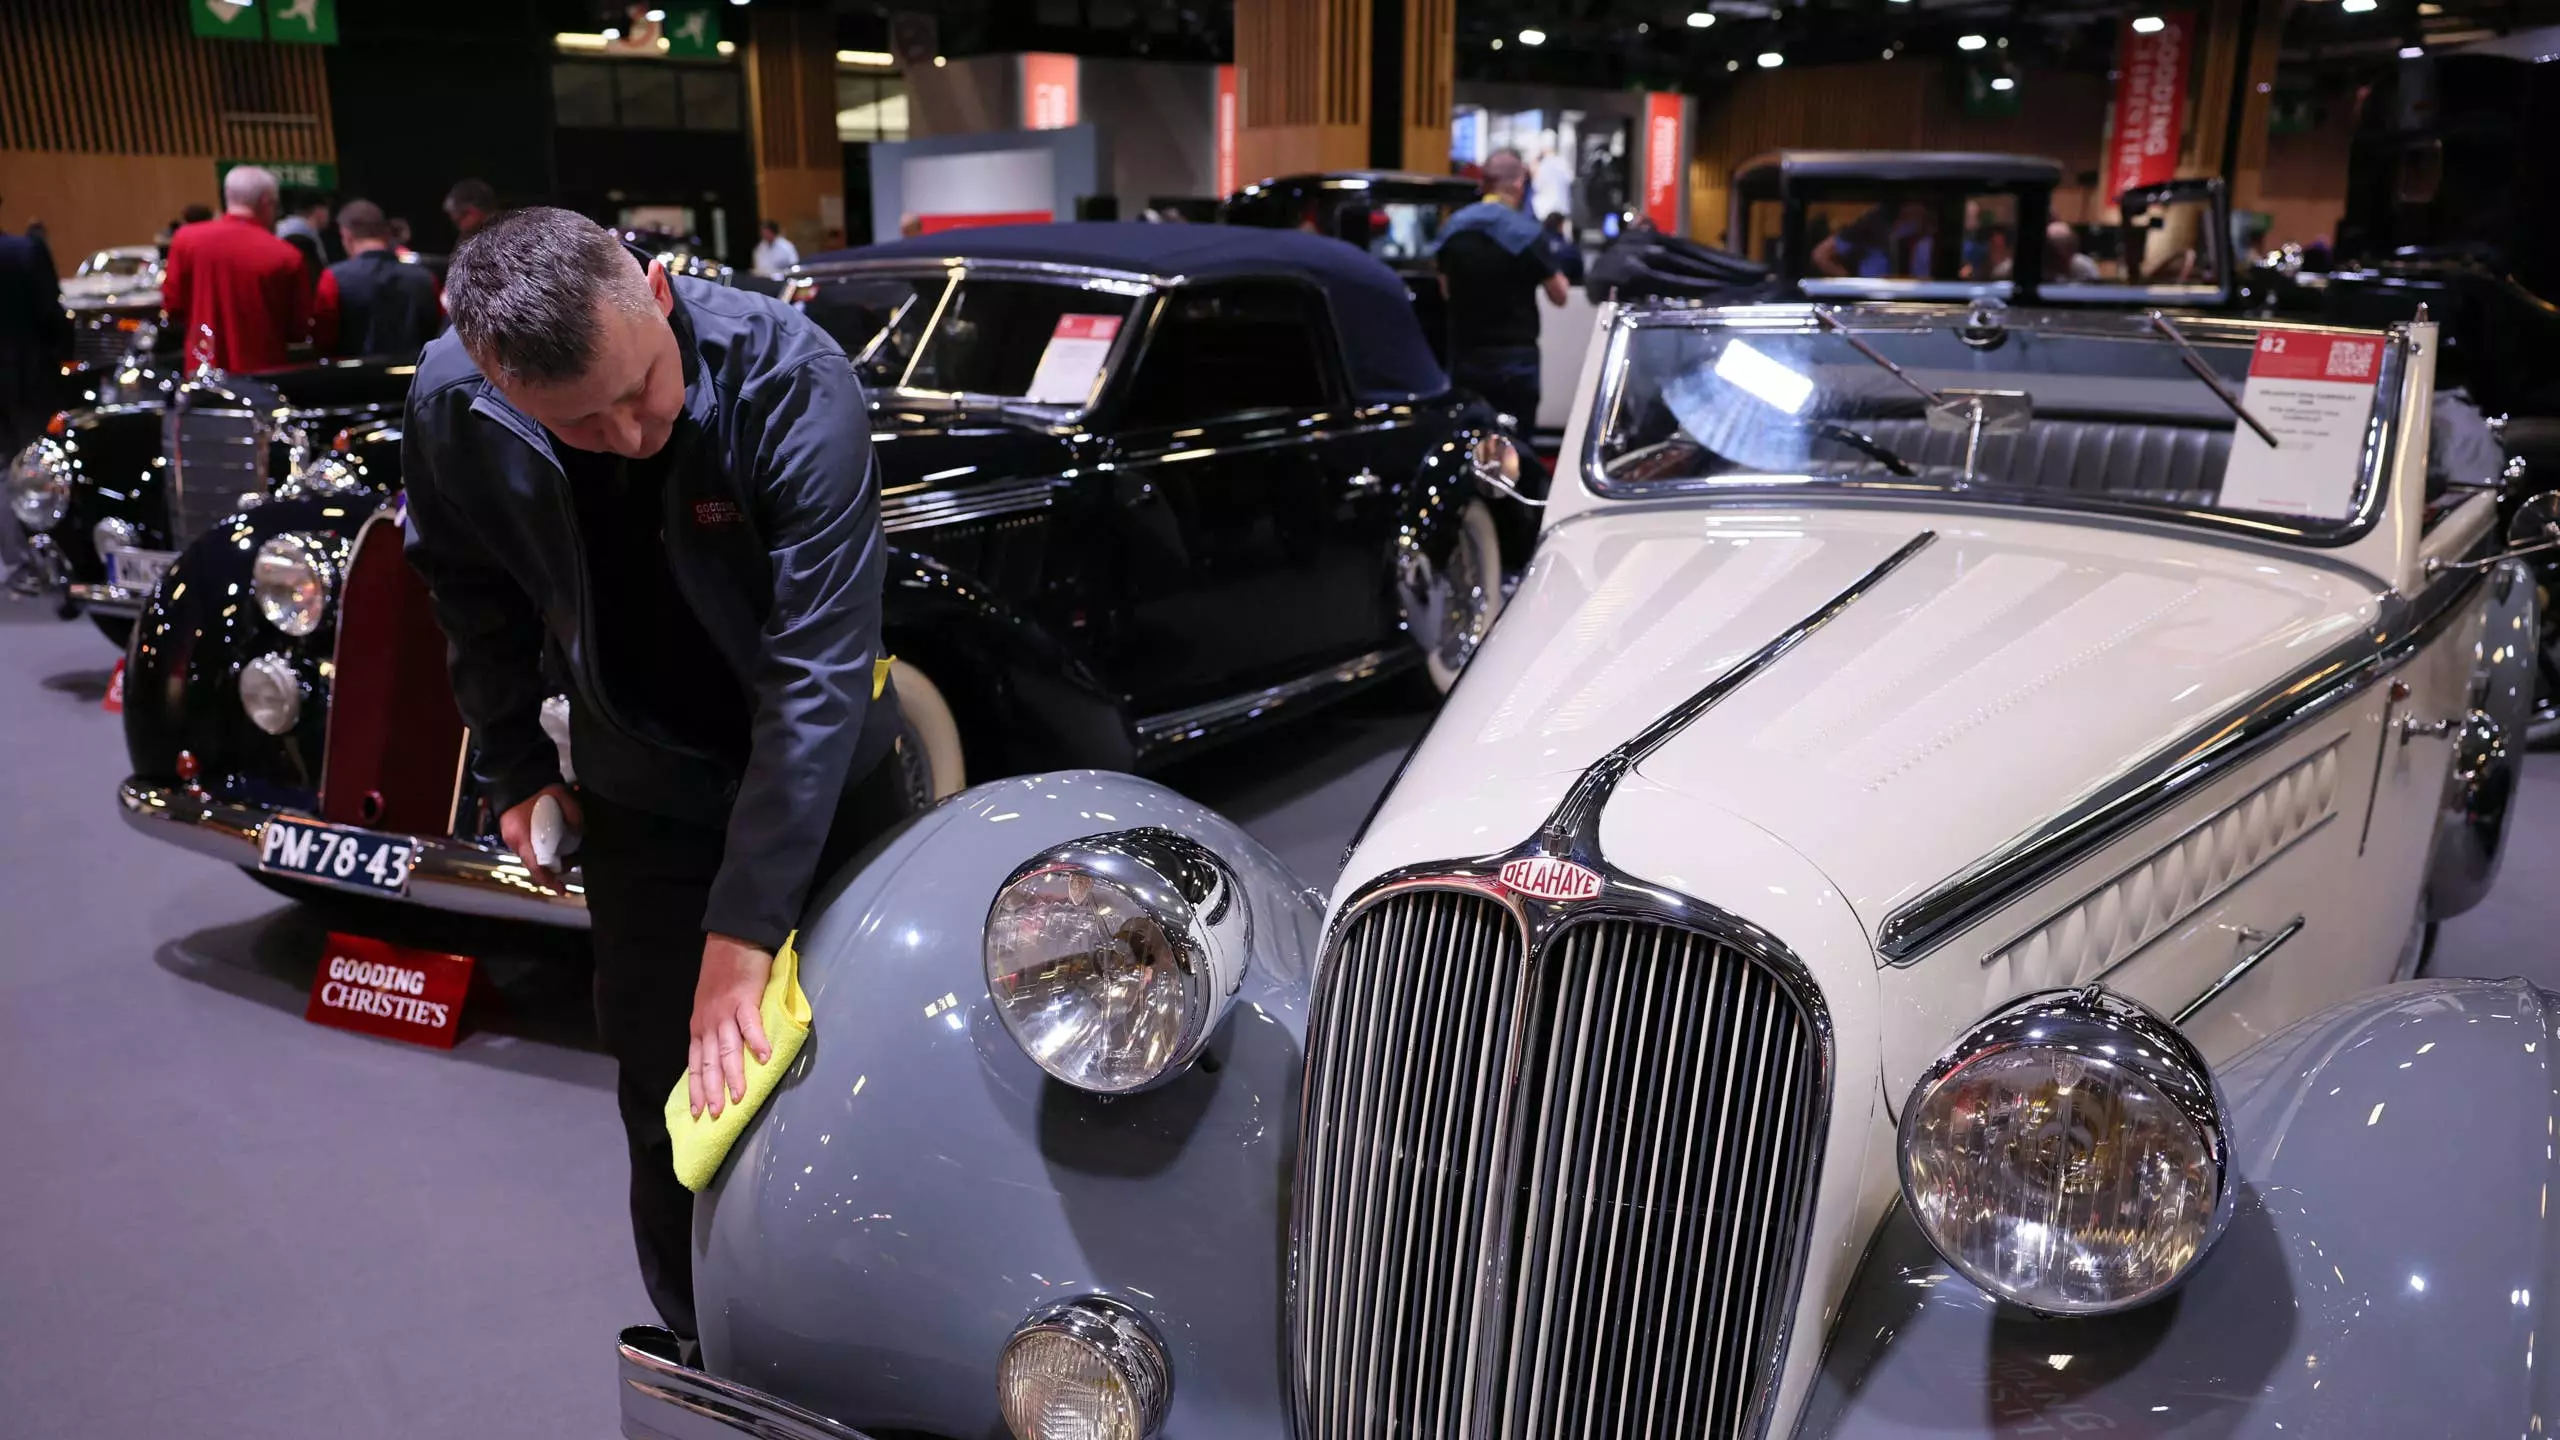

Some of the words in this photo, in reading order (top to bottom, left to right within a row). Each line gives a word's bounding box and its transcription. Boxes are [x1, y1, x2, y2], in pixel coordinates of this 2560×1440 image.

[262, 822, 411, 887] PM-78-43
[1503, 861, 1596, 896] DELAHAYE
[328, 956, 426, 995] GOODING
[321, 981, 449, 1028] CHRISTIE'S
